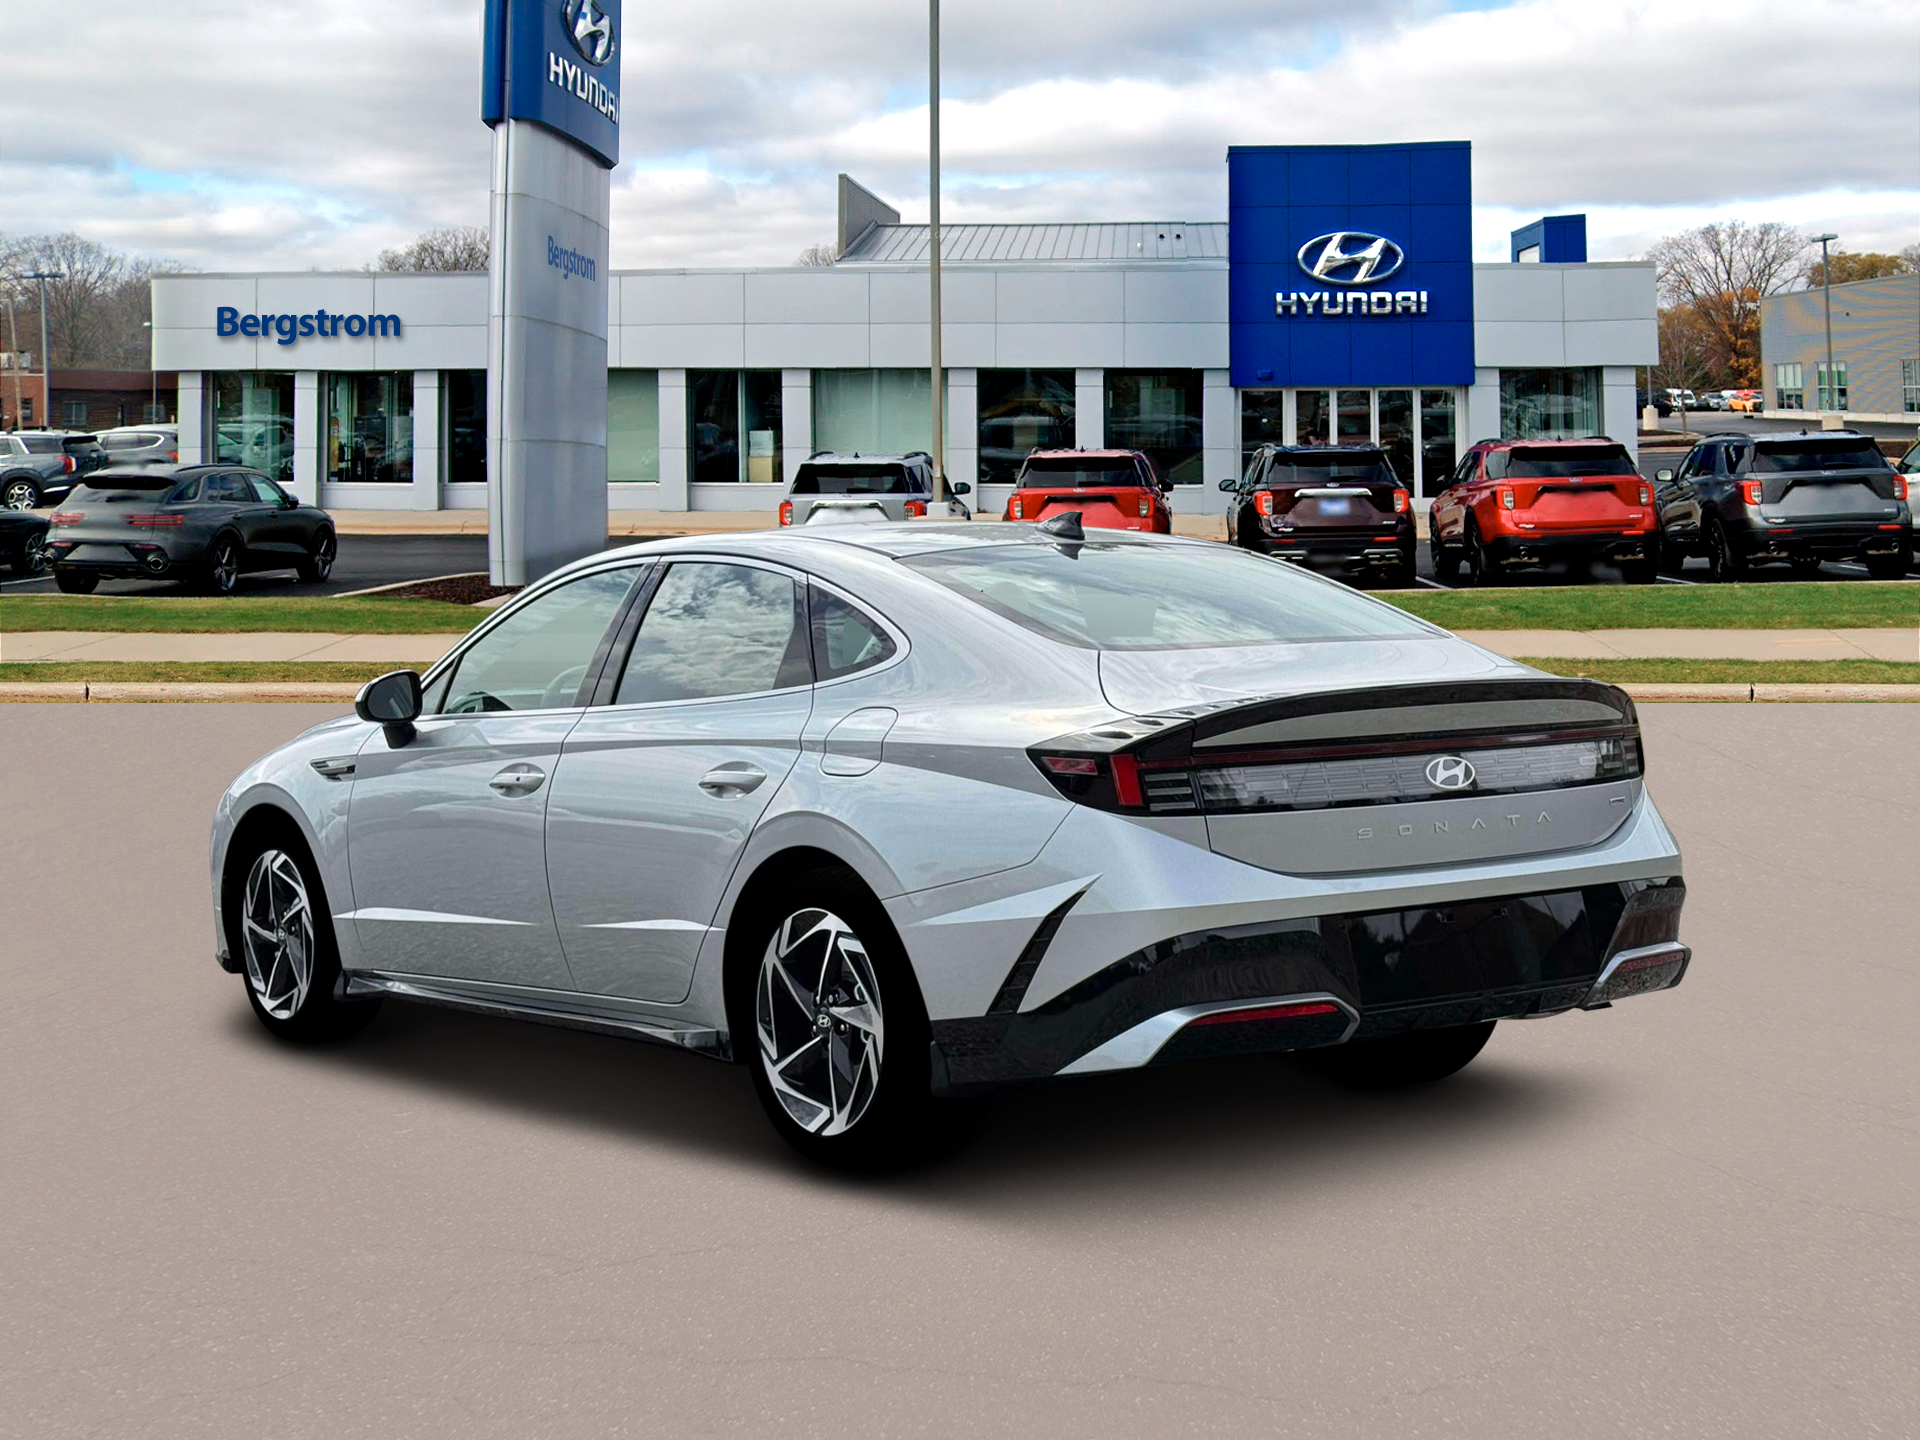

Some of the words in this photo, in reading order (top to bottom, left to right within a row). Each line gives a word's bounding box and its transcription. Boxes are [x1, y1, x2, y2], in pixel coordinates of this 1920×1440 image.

[549, 51, 619, 124] HYUNDAI
[547, 235, 596, 281] Bergstrom
[1275, 290, 1428, 315] HYUNDAI
[216, 306, 401, 346] Bergstrom
[1357, 811, 1552, 840] SONATA
